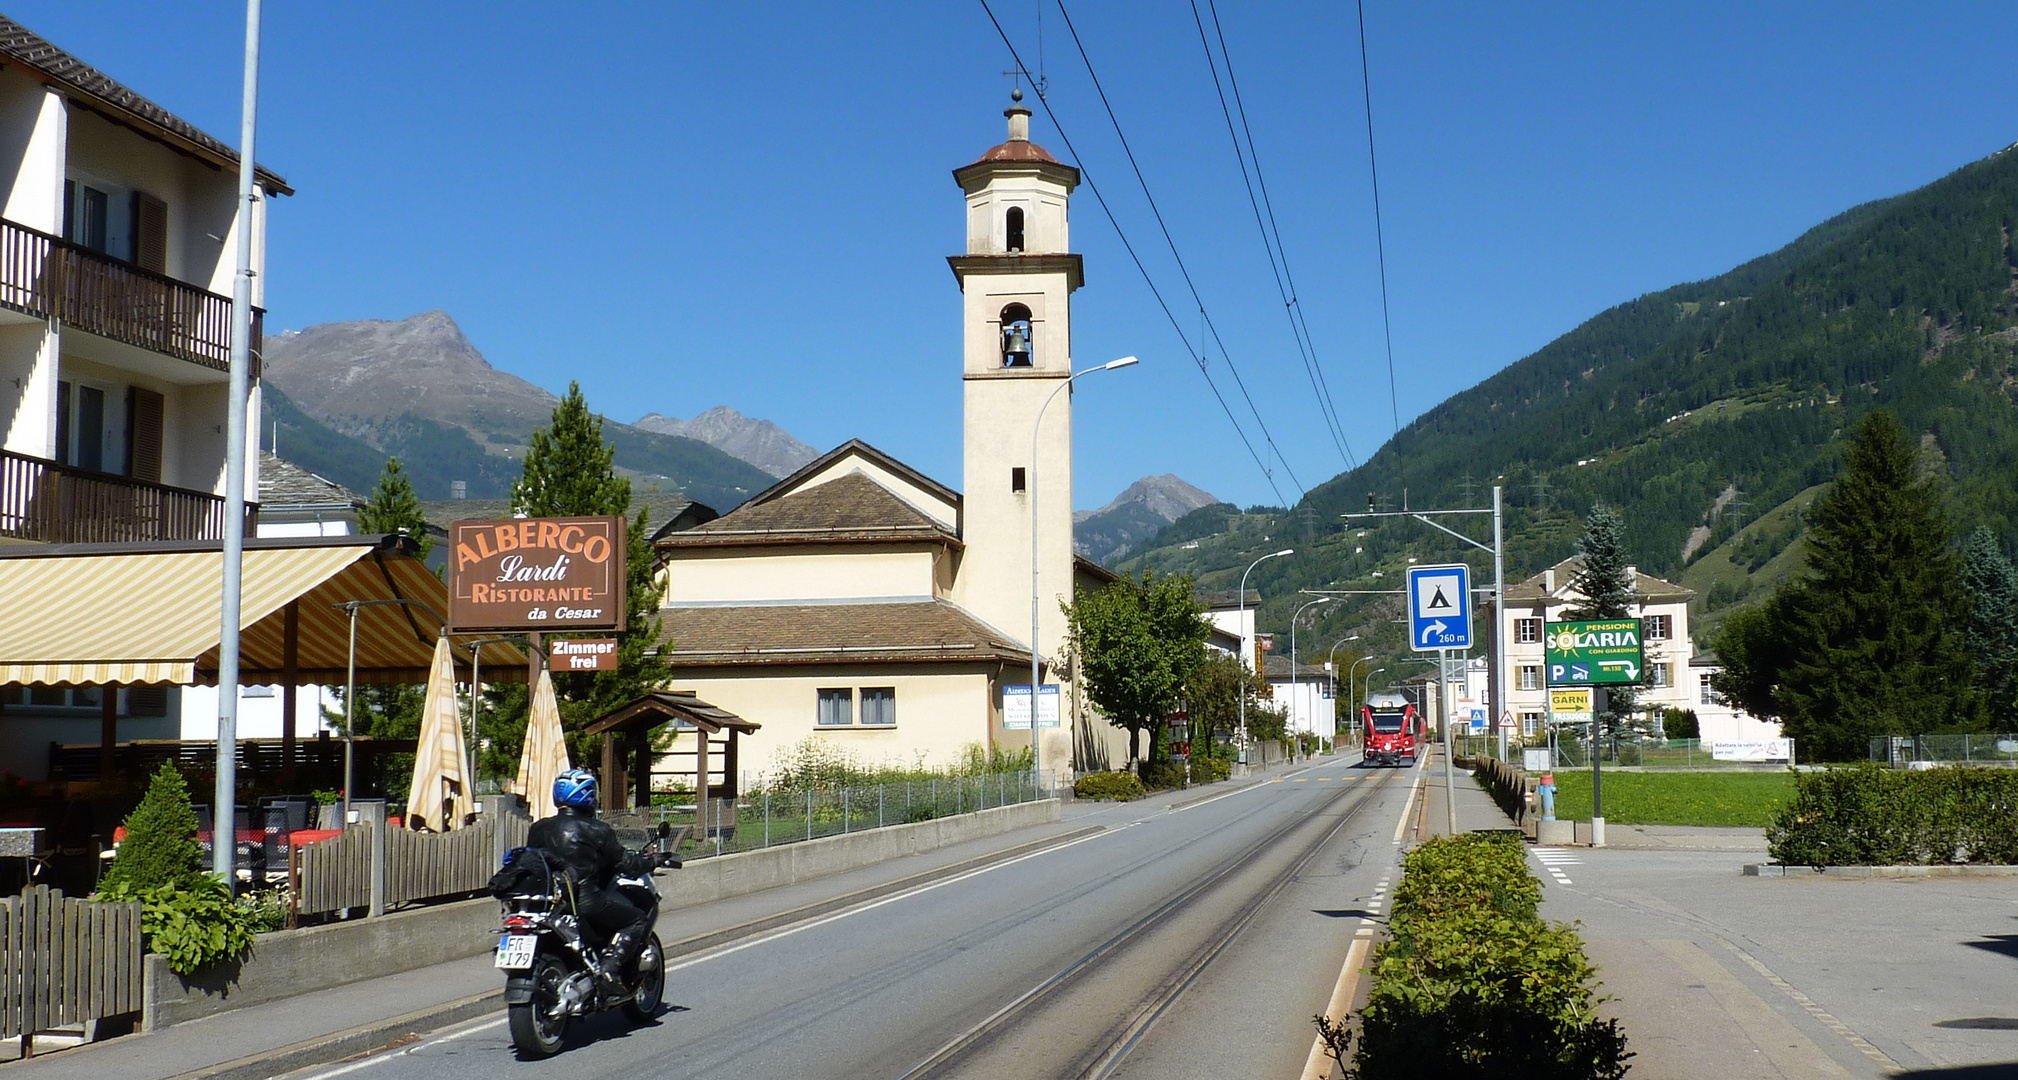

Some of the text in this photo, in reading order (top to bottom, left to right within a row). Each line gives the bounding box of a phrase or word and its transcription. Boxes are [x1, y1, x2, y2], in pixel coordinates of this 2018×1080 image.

[456, 521, 611, 572] ALBERGO
[496, 554, 570, 582] Lardi
[527, 607, 602, 620] da Cesar
[1586, 623, 1636, 631] PENSIONE
[1439, 634, 1466, 643] 260 m
[1547, 632, 1638, 650] SOLARIA
[552, 641, 614, 655] Zimmer
[570, 655, 598, 669] frei
[1552, 664, 1565, 681] P
[1552, 696, 1588, 704] GARNI
[507, 937, 524, 951] FR
